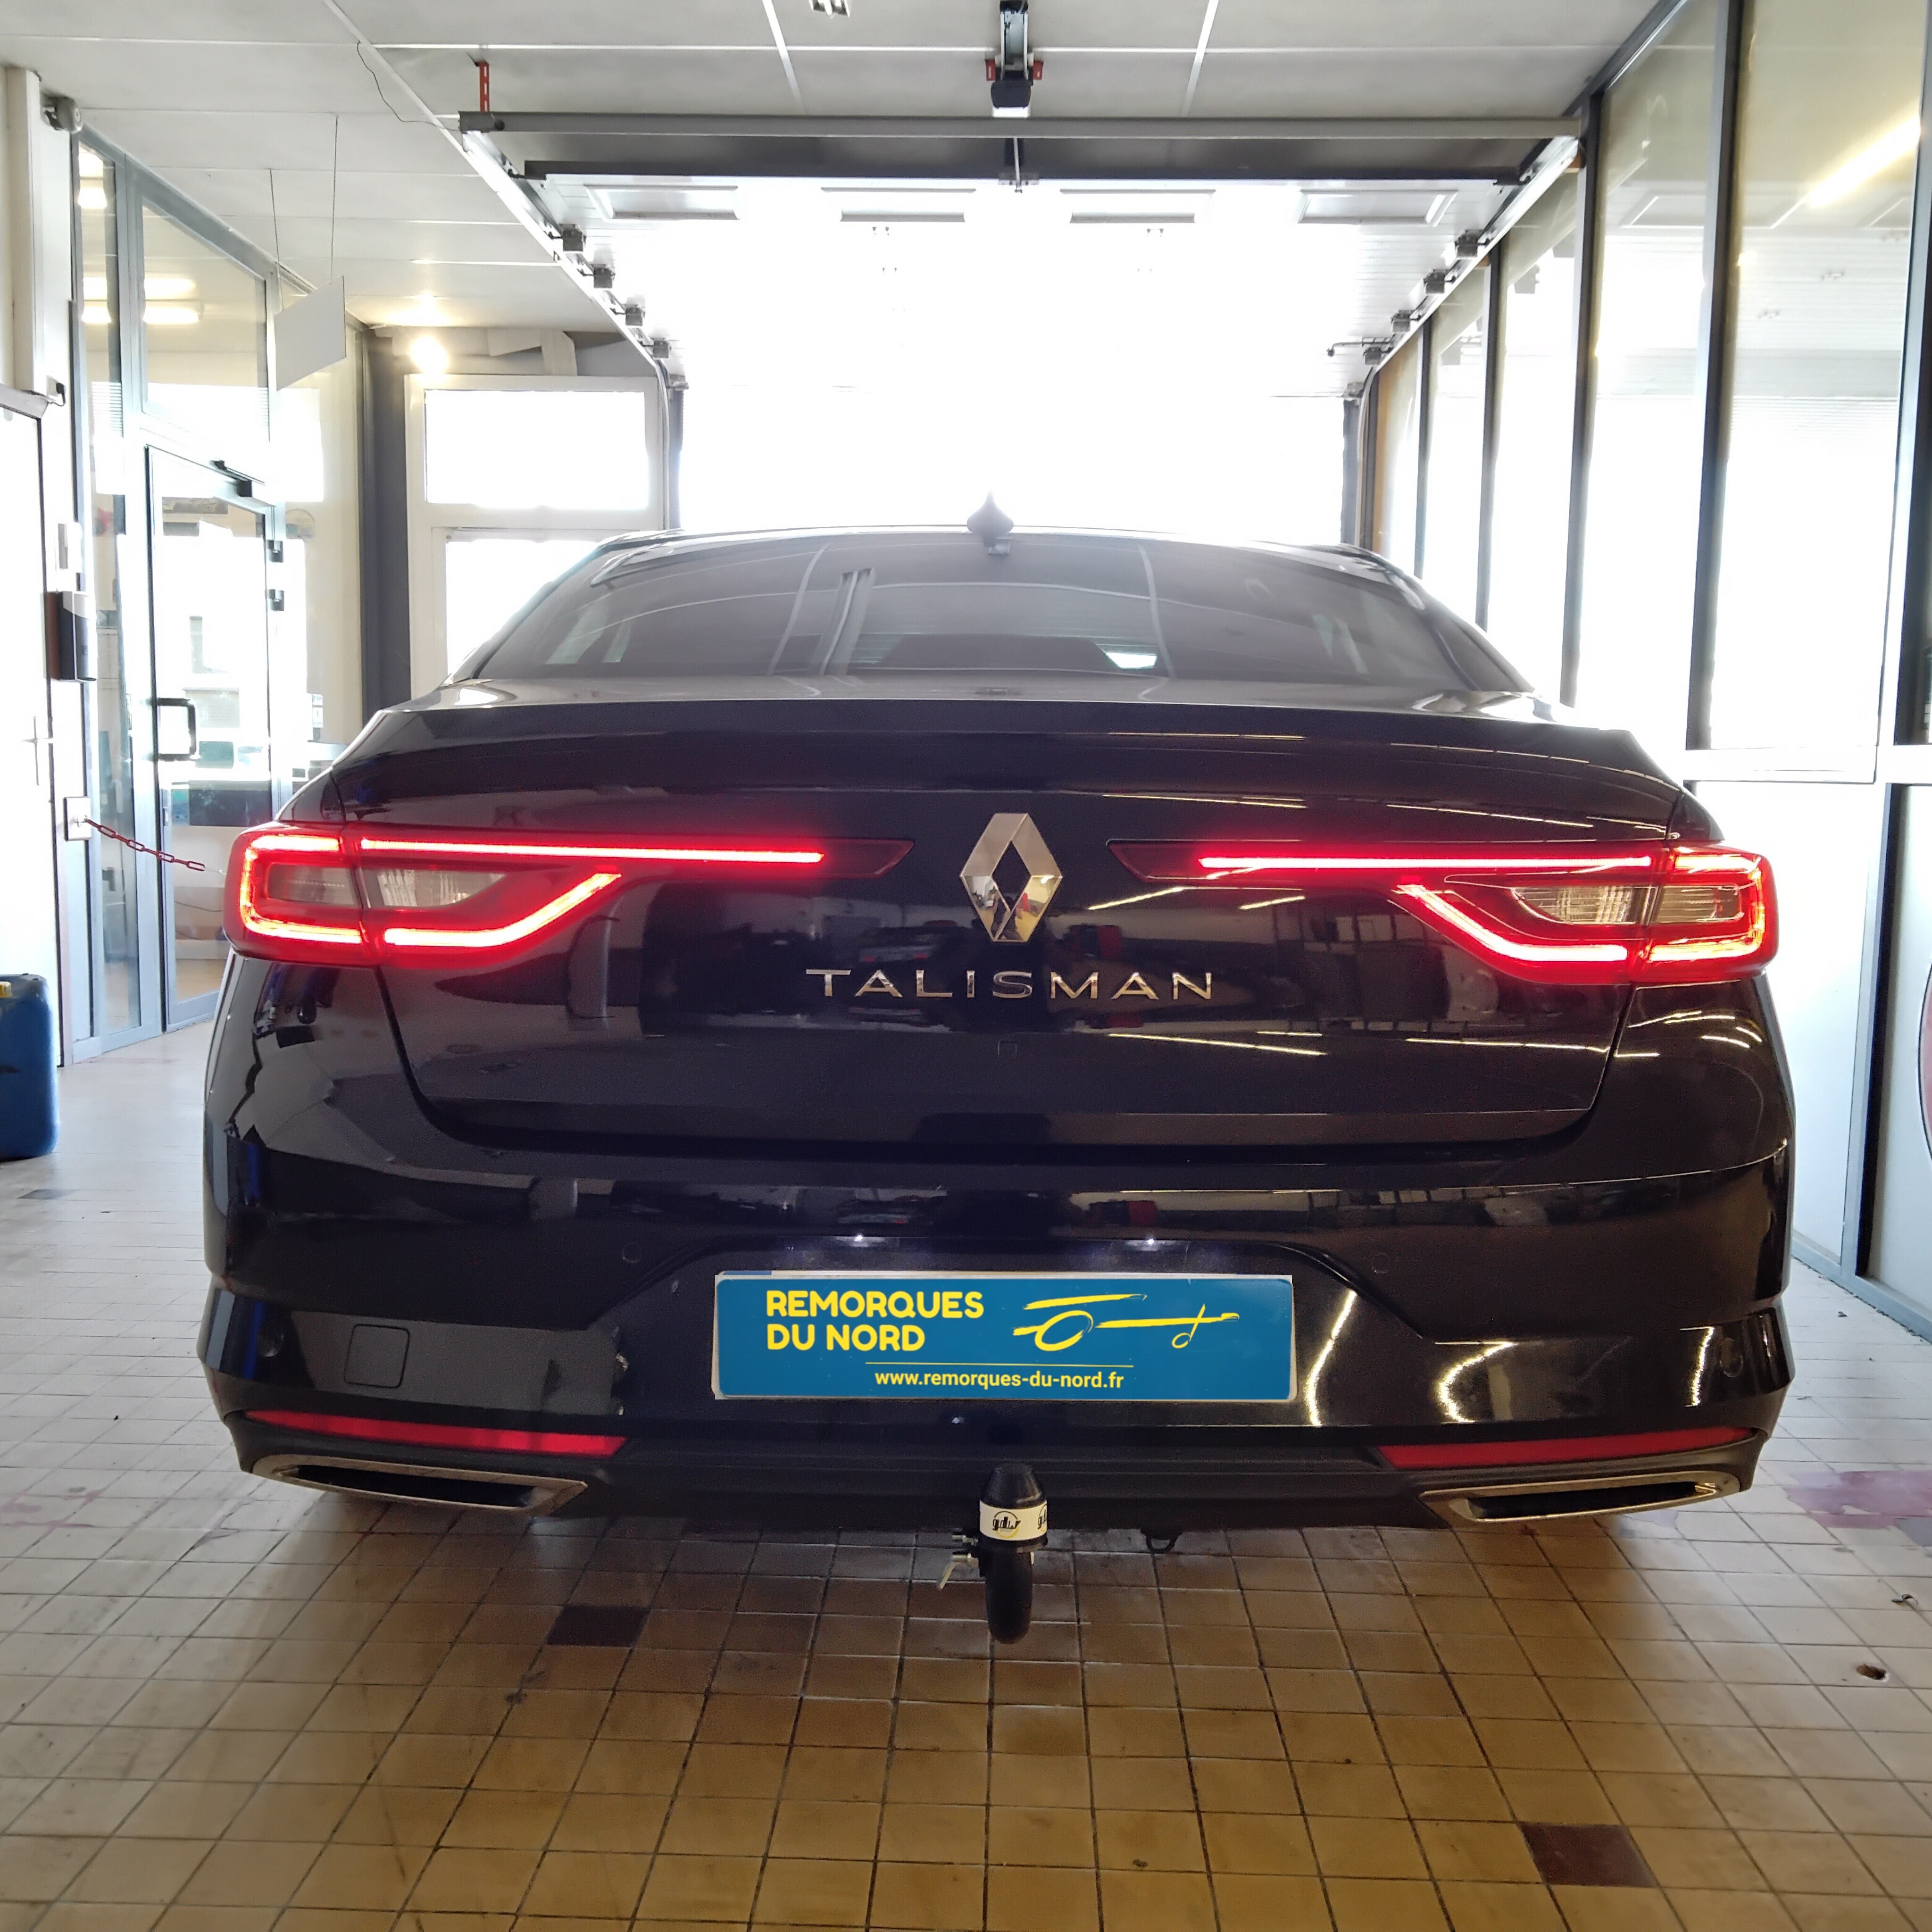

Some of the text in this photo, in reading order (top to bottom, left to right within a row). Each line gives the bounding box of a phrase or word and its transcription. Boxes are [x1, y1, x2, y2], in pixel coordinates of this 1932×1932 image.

[806, 969, 1212, 1000] TALISMAN
[766, 1290, 984, 1318] REMORQUES
[767, 1324, 925, 1351] DU NORD
[874, 1370, 1124, 1390] www.remorques-du-nord.fr
